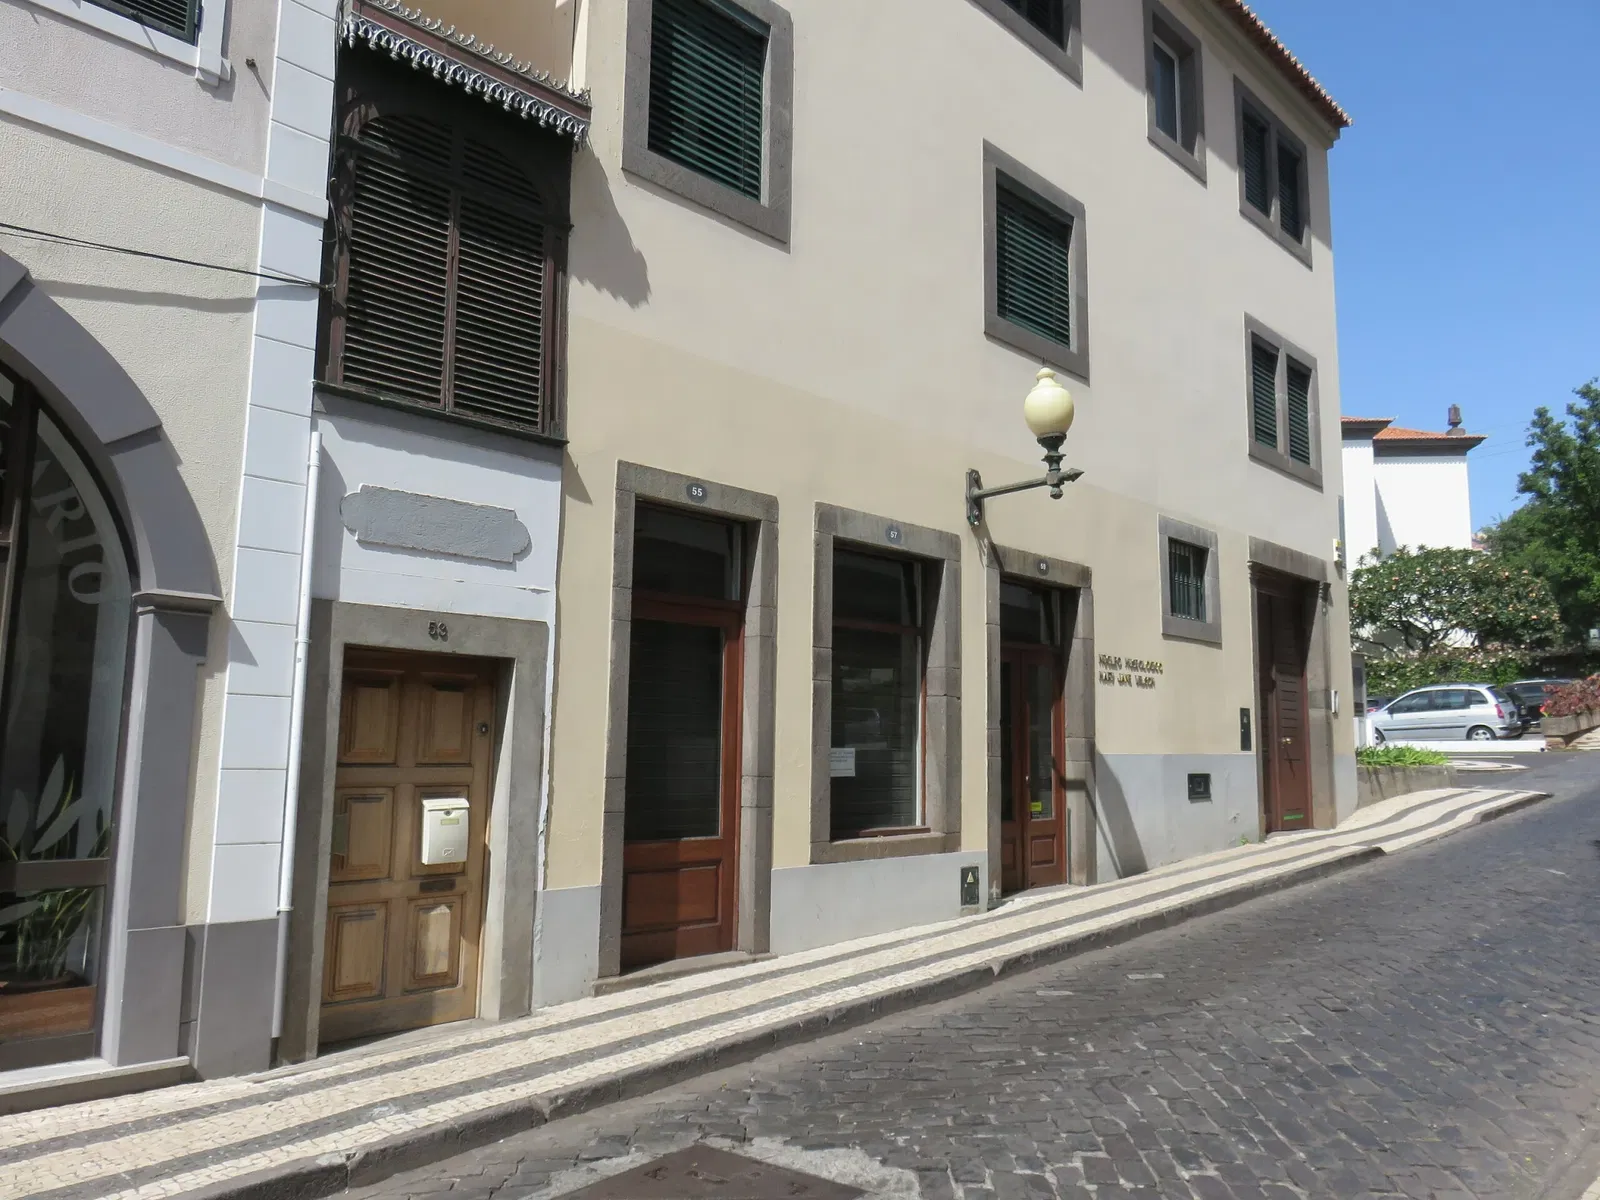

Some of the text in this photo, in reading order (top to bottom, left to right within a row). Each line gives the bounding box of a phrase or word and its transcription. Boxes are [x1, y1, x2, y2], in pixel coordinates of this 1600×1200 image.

[692, 487, 703, 497] 55
[890, 531, 897, 539] 57
[428, 620, 448, 639] 53
